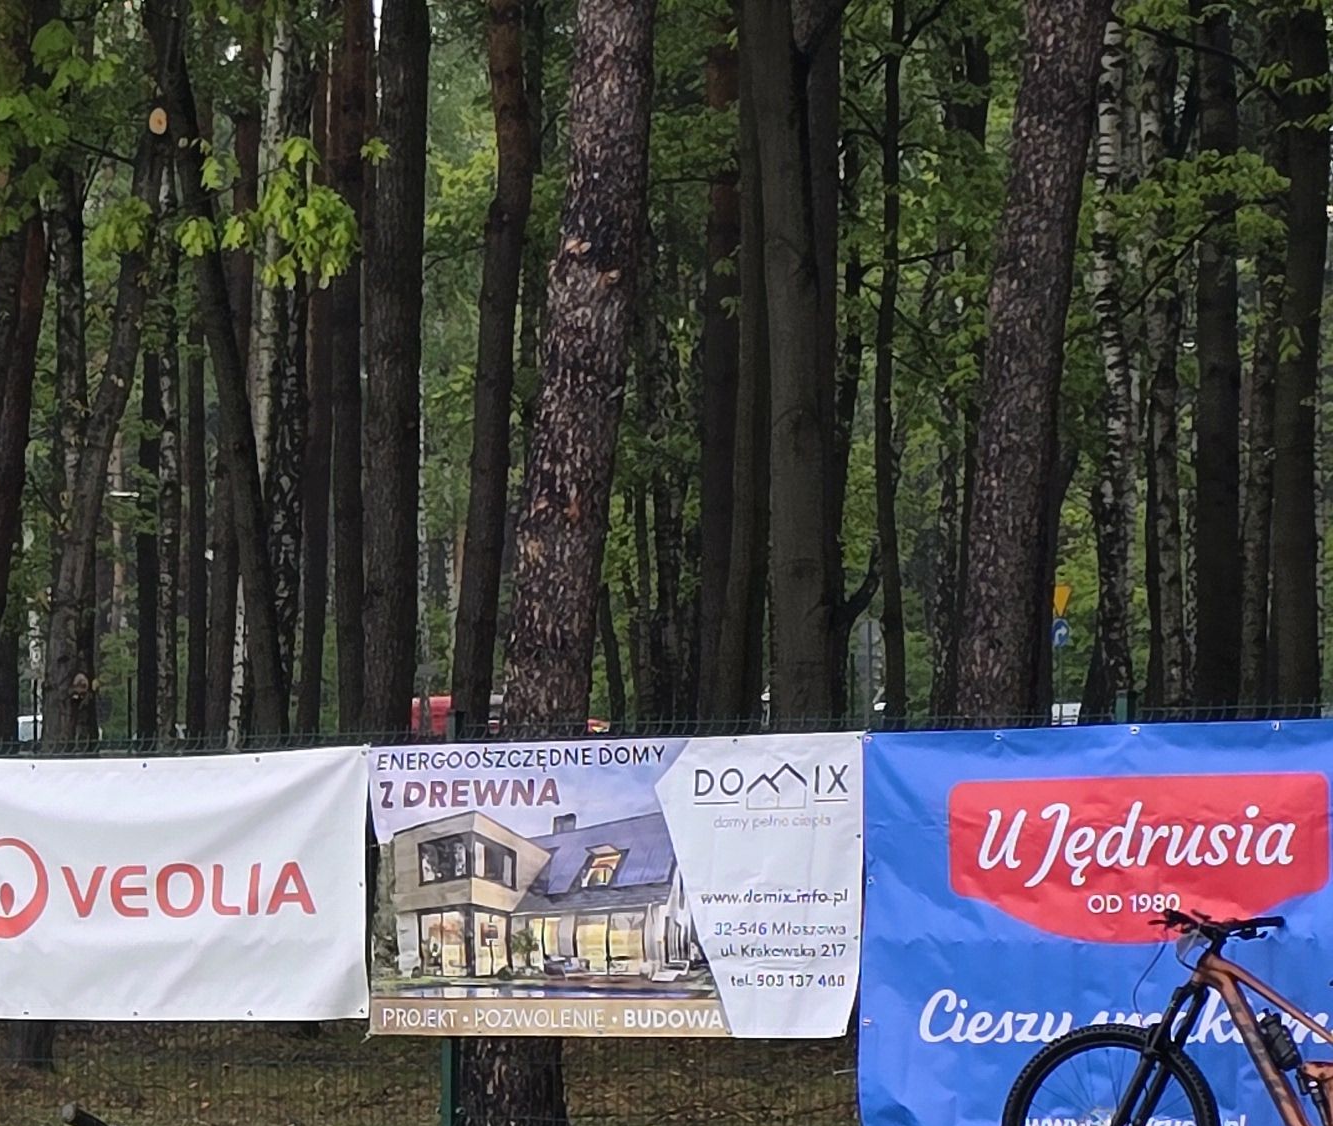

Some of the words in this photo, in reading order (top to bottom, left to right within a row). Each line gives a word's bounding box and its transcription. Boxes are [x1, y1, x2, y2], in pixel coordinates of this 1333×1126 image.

[599, 744, 665, 765] DOMY
[379, 781, 393, 808] Z
[403, 778, 560, 808] DREWNA
[1024, 801, 1296, 887] Jędrusia
[61, 861, 316, 918] VEOLIA
[1087, 895, 1122, 913] OD
[1129, 893, 1181, 913] 1980
[821, 943, 846, 957] 217
[383, 1008, 457, 1029] PROJEKT
[474, 1008, 605, 1029] POZWOLENIE
[624, 1008, 724, 1029] BUDOWA
